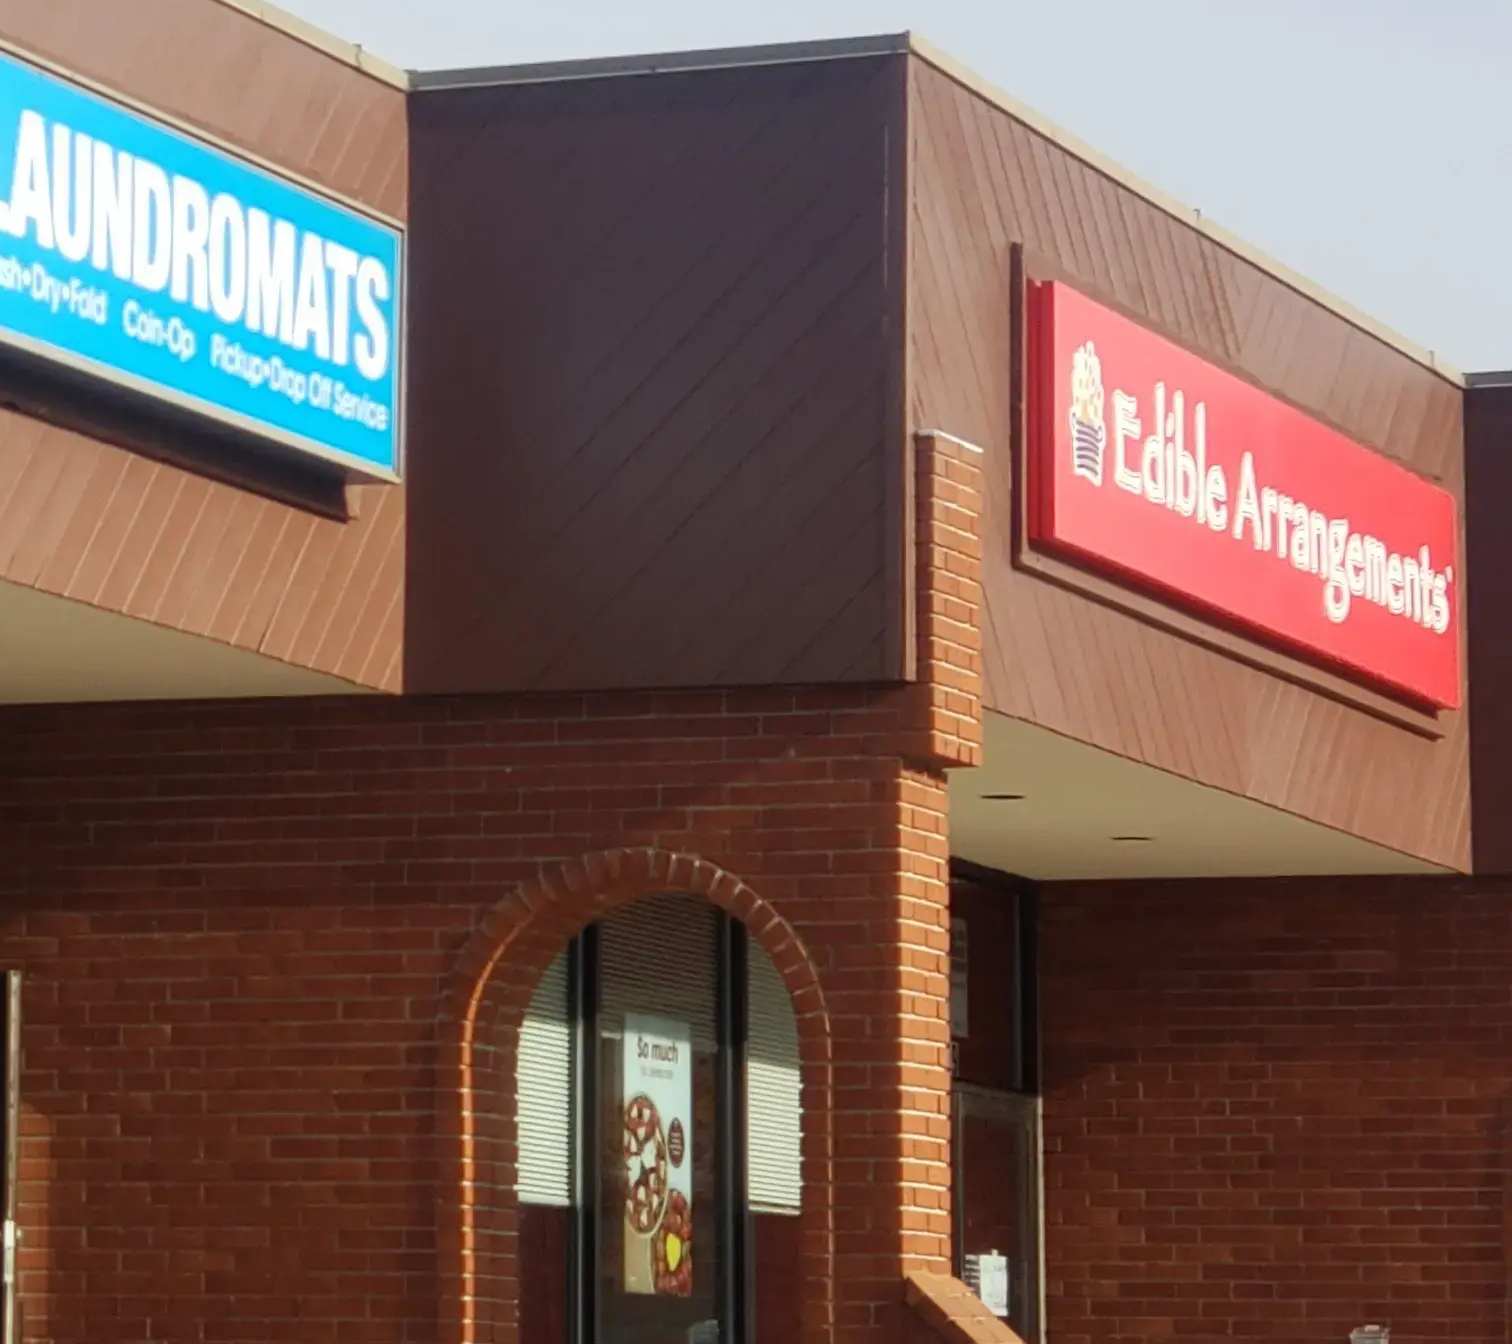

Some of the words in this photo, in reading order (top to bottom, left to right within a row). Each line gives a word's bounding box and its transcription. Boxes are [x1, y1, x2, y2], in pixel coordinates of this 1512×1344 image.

[122, 298, 196, 362] Coin-Op
[308, 371, 333, 410] Off
[334, 380, 388, 431] Service
[1111, 381, 1228, 531] Edible
[637, 1035, 650, 1059] So
[651, 1040, 679, 1065] much
